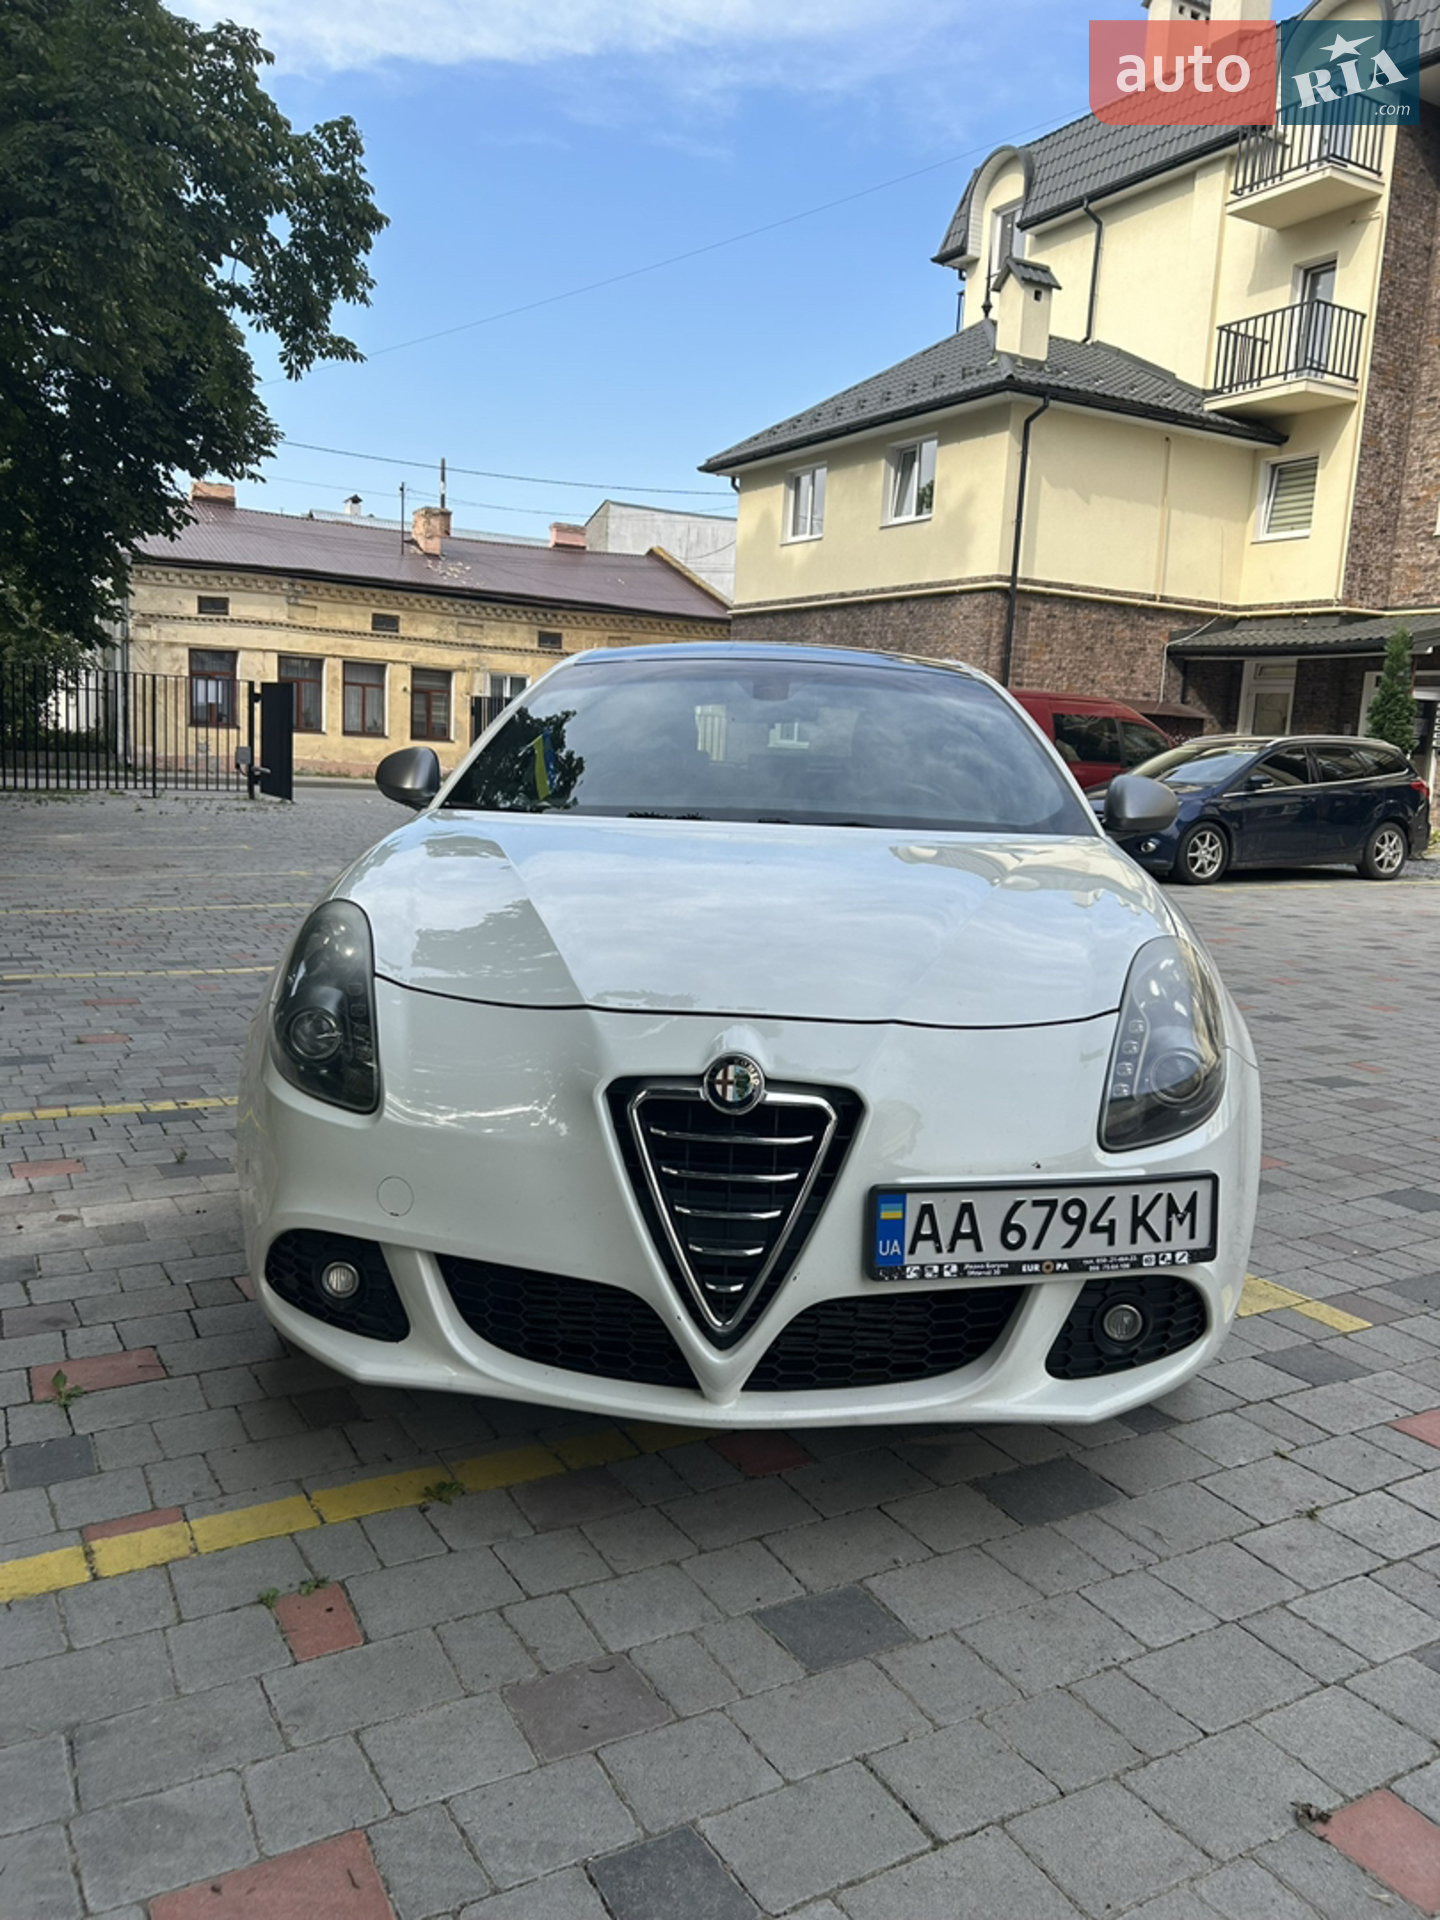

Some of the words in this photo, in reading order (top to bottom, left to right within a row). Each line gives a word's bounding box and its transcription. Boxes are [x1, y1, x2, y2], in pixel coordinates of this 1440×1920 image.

[907, 1201, 984, 1255] AA
[1000, 1195, 1117, 1252] 6794
[1130, 1190, 1198, 1245] KM
[879, 1240, 901, 1256] UA
